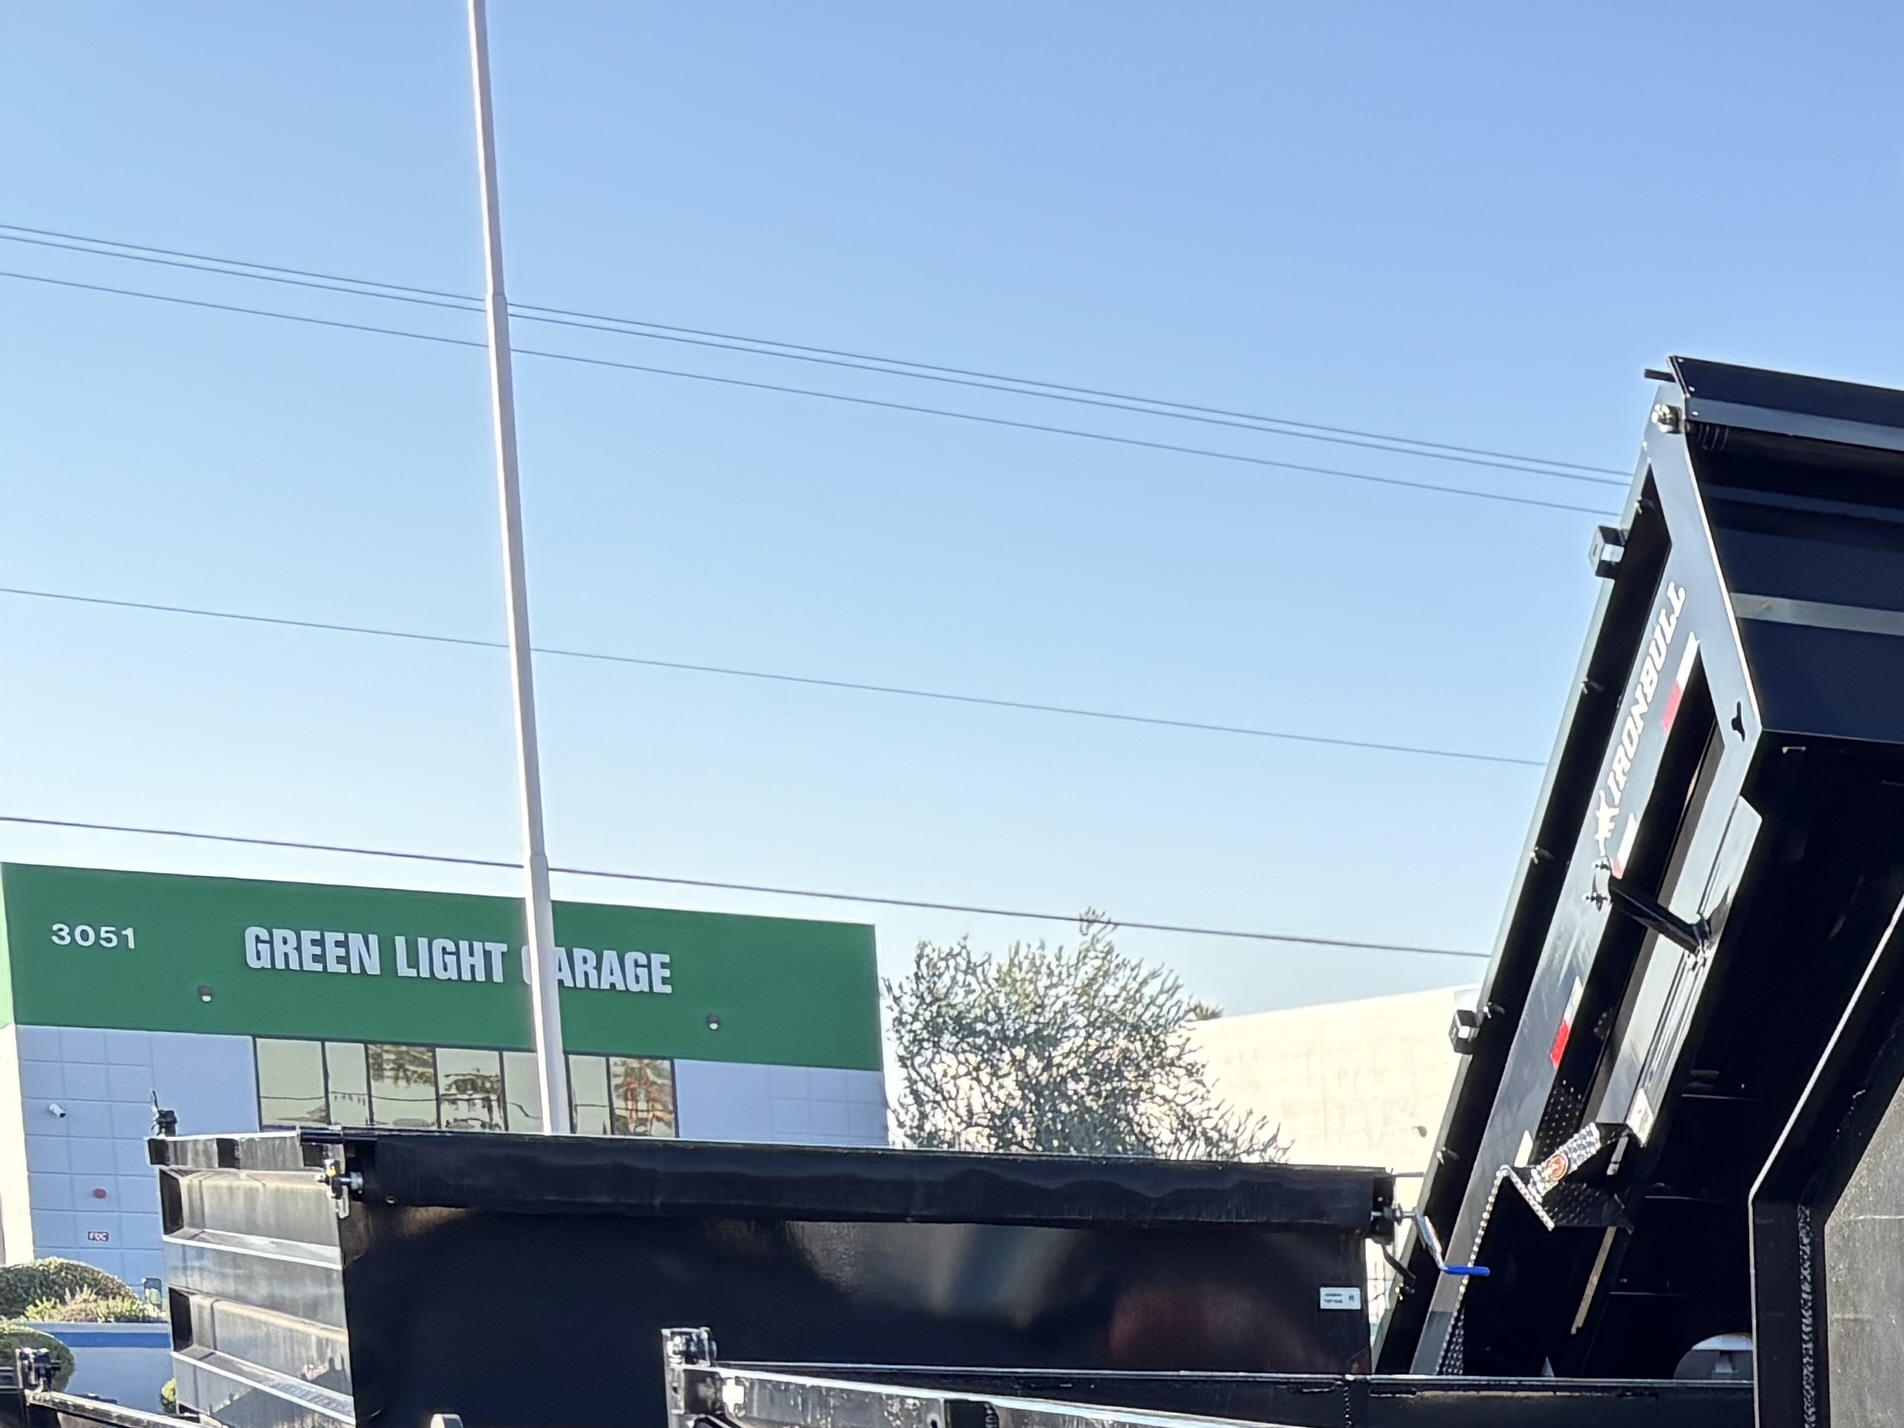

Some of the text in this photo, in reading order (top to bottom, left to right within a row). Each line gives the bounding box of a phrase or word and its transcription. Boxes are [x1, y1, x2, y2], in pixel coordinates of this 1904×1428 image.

[1606, 581, 1686, 806] IRONBULL
[51, 922, 136, 950] 3051
[243, 925, 673, 994] GREEN LIGHT ARAGE
